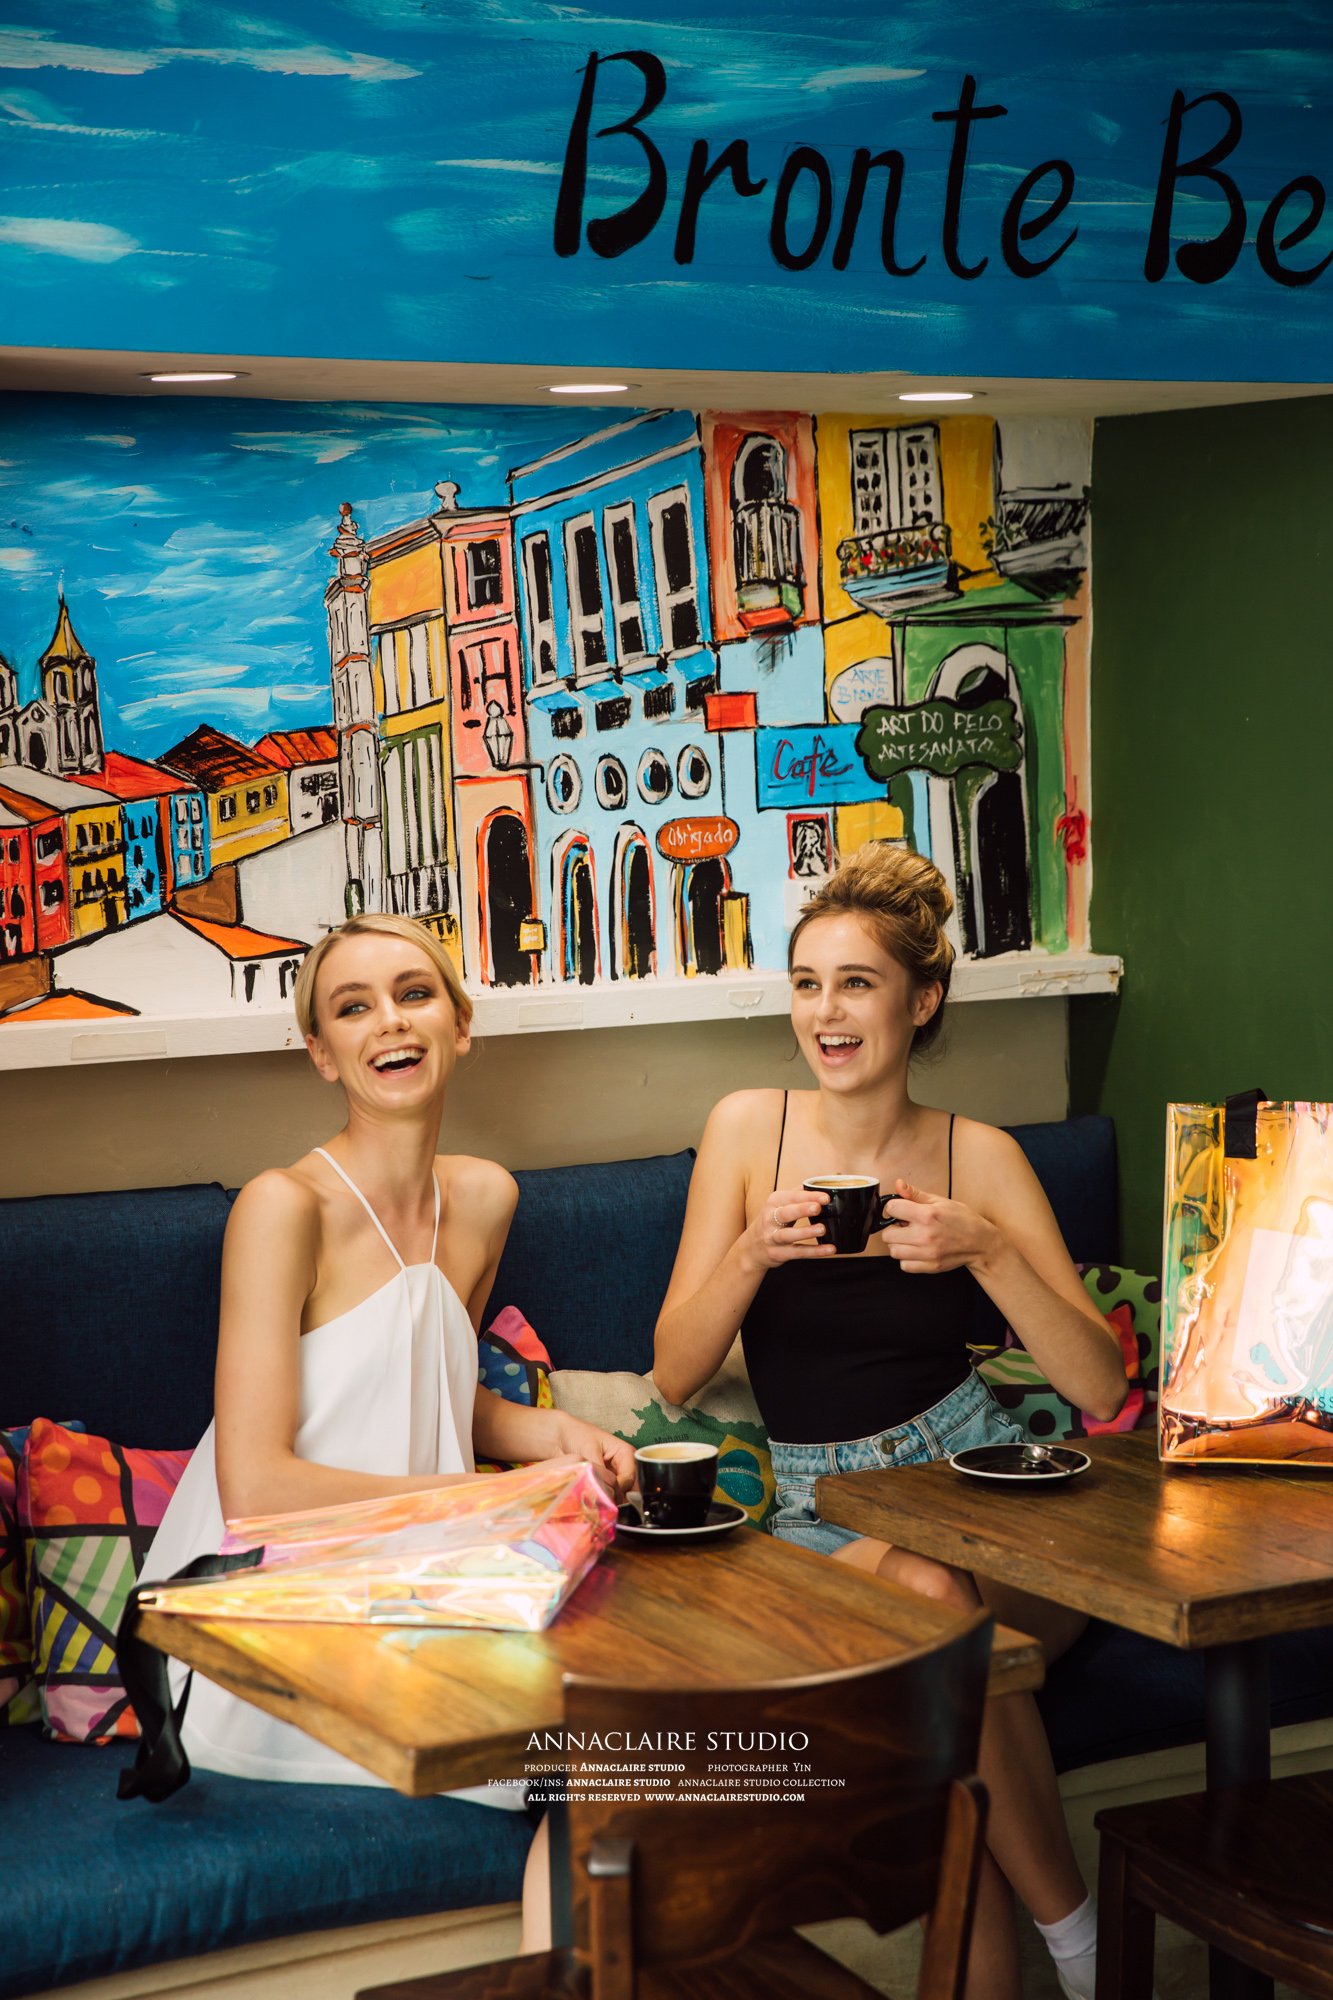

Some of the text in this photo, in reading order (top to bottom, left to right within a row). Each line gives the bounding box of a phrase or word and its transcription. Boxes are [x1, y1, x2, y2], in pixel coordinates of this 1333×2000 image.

[553, 50, 1333, 287] Bronte Be
[876, 712, 916, 736] ART
[921, 710, 944, 734] DO
[878, 736, 994, 763] ARTESANATO
[668, 822, 733, 854] Obrigado
